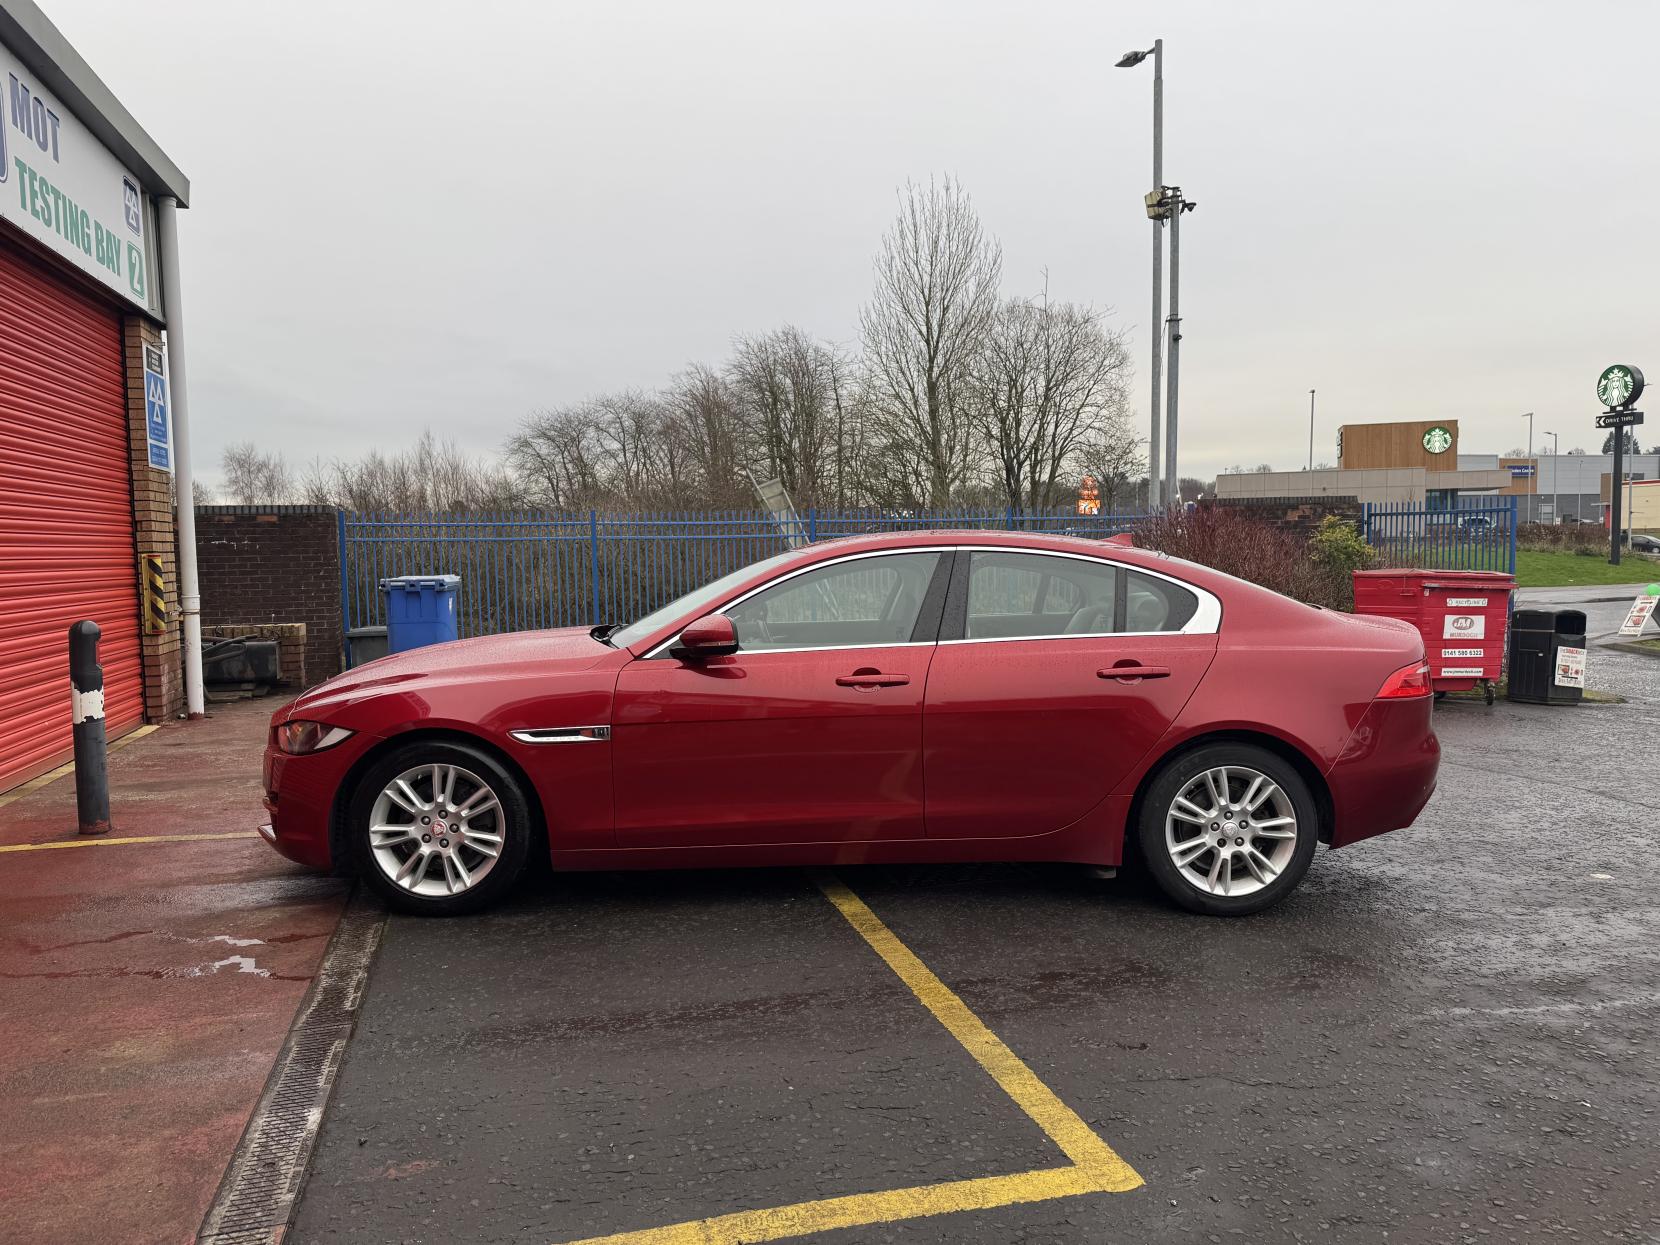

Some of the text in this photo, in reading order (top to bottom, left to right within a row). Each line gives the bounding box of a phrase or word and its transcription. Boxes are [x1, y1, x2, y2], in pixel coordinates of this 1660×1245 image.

[9, 72, 60, 163] MOT
[14, 155, 91, 257] TESTING
[94, 219, 121, 277] BAY
